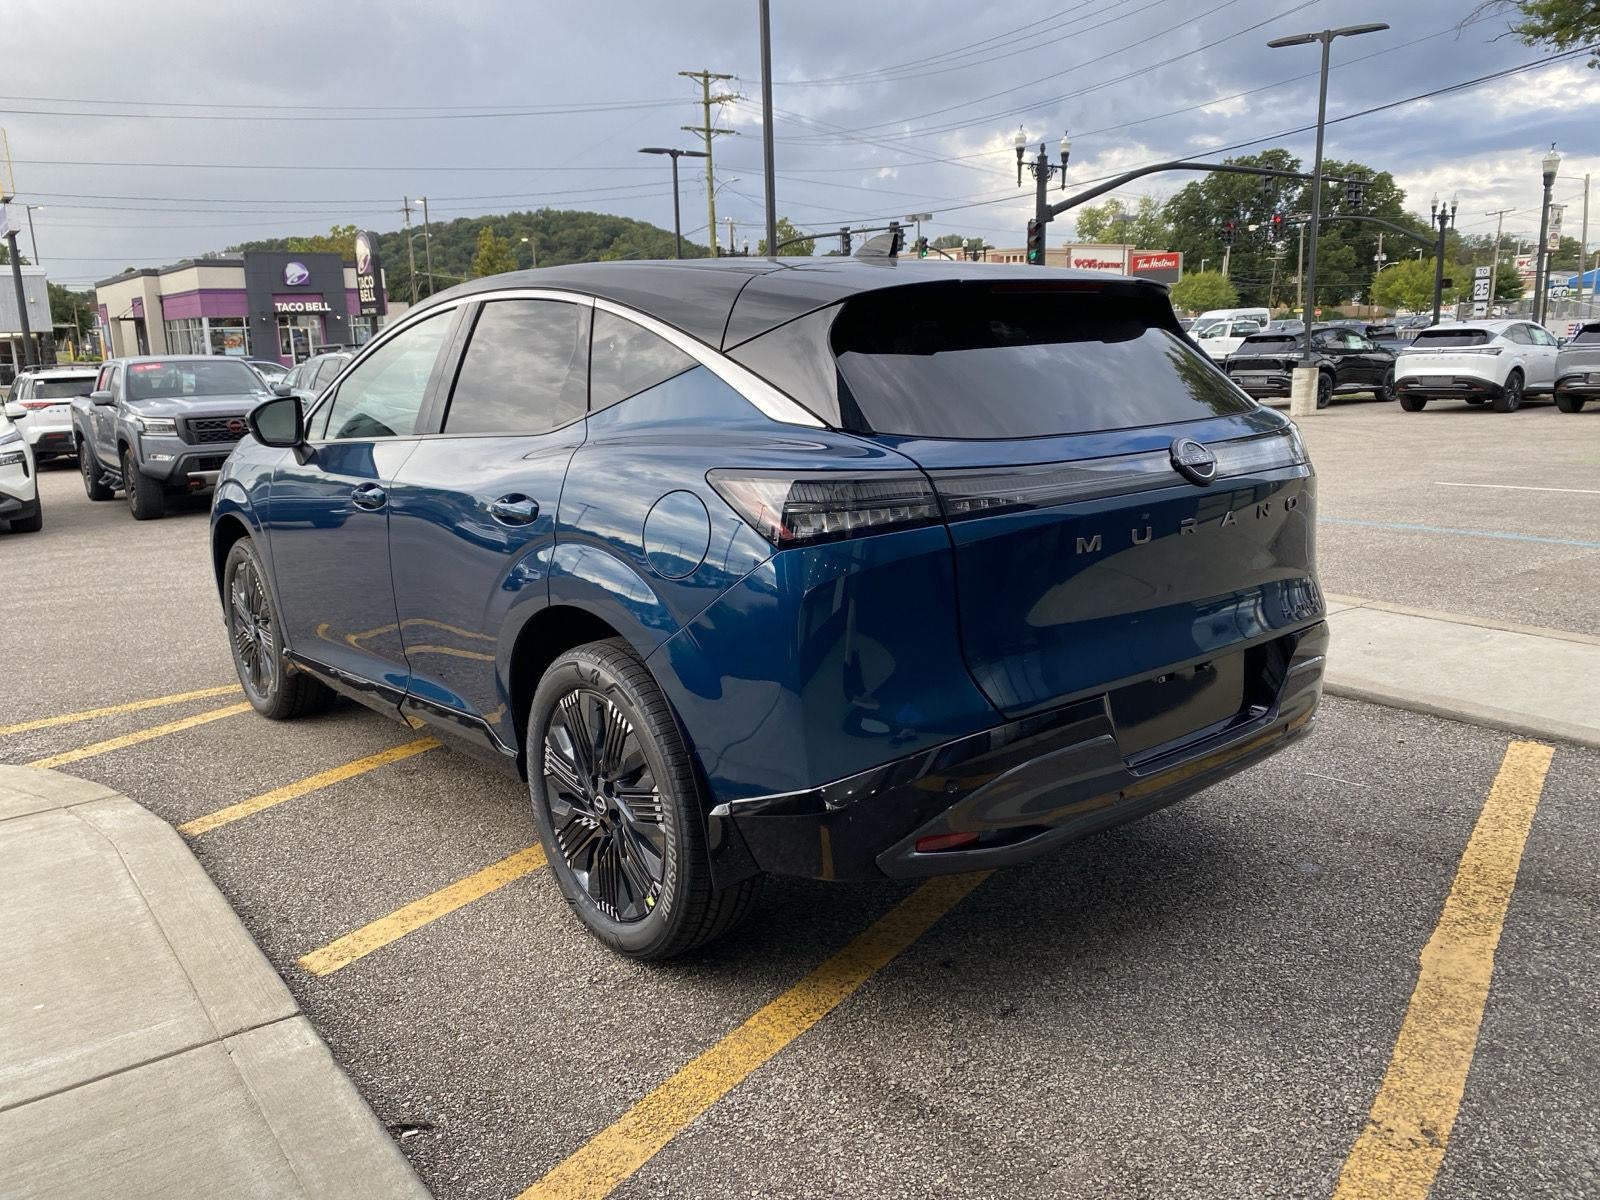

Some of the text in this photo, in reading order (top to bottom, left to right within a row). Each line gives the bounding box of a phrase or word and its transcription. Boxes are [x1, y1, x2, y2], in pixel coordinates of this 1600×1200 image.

[1137, 257, 1175, 269] Tim Hortons
[357, 275, 374, 290] TACO
[360, 289, 376, 302] BELL
[1475, 283, 1489, 296] 25
[1553, 289, 1568, 299] 60
[275, 302, 331, 311] TACO BELL
[1076, 495, 1297, 555] MURANO
